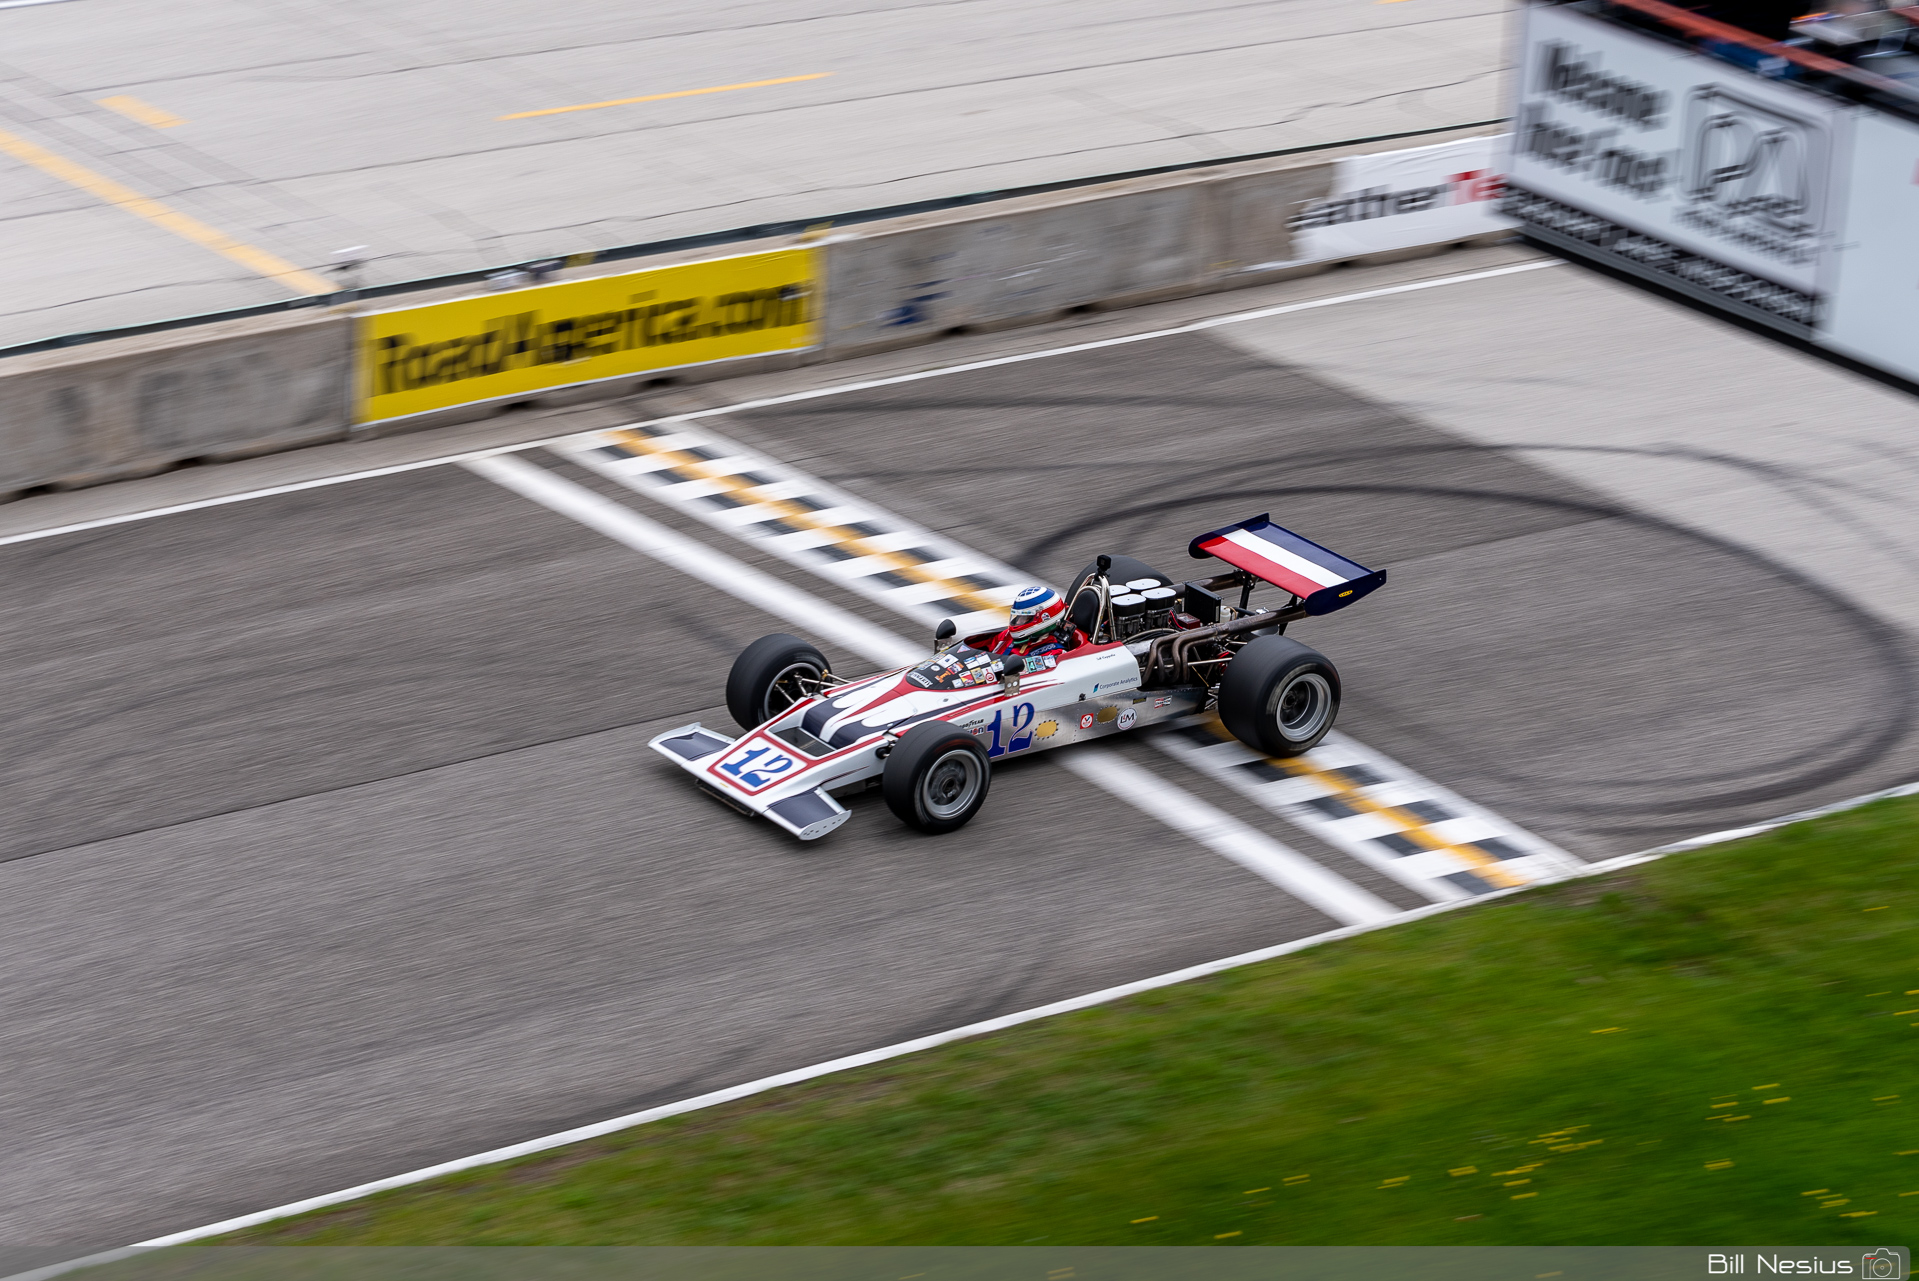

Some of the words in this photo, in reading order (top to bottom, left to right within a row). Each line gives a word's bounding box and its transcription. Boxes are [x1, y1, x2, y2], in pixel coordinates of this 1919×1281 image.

[373, 283, 813, 396] RoadAmerica.com
[985, 702, 1035, 758] 12
[720, 746, 793, 788] 12
